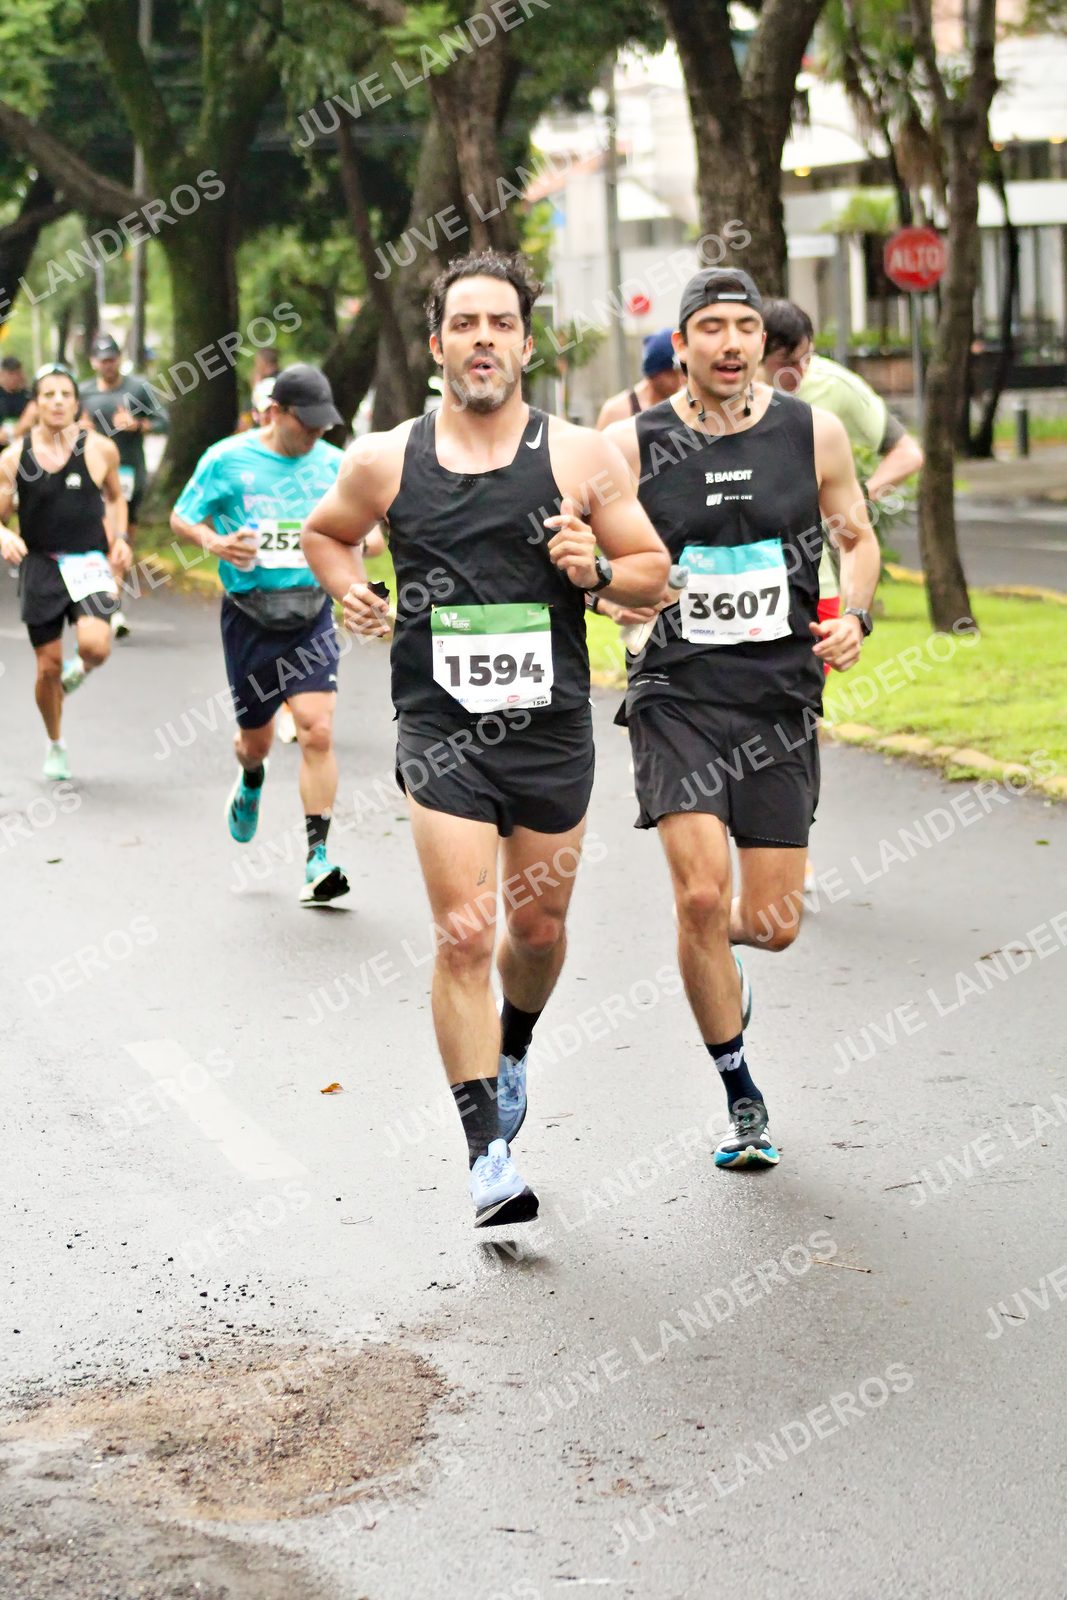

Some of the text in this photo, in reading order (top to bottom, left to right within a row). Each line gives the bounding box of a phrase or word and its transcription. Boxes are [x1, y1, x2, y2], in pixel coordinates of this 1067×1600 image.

[890, 246, 942, 273] ALTO
[714, 469, 753, 483] BANDIT
[688, 586, 781, 621] 3607
[445, 652, 544, 687] 1594
